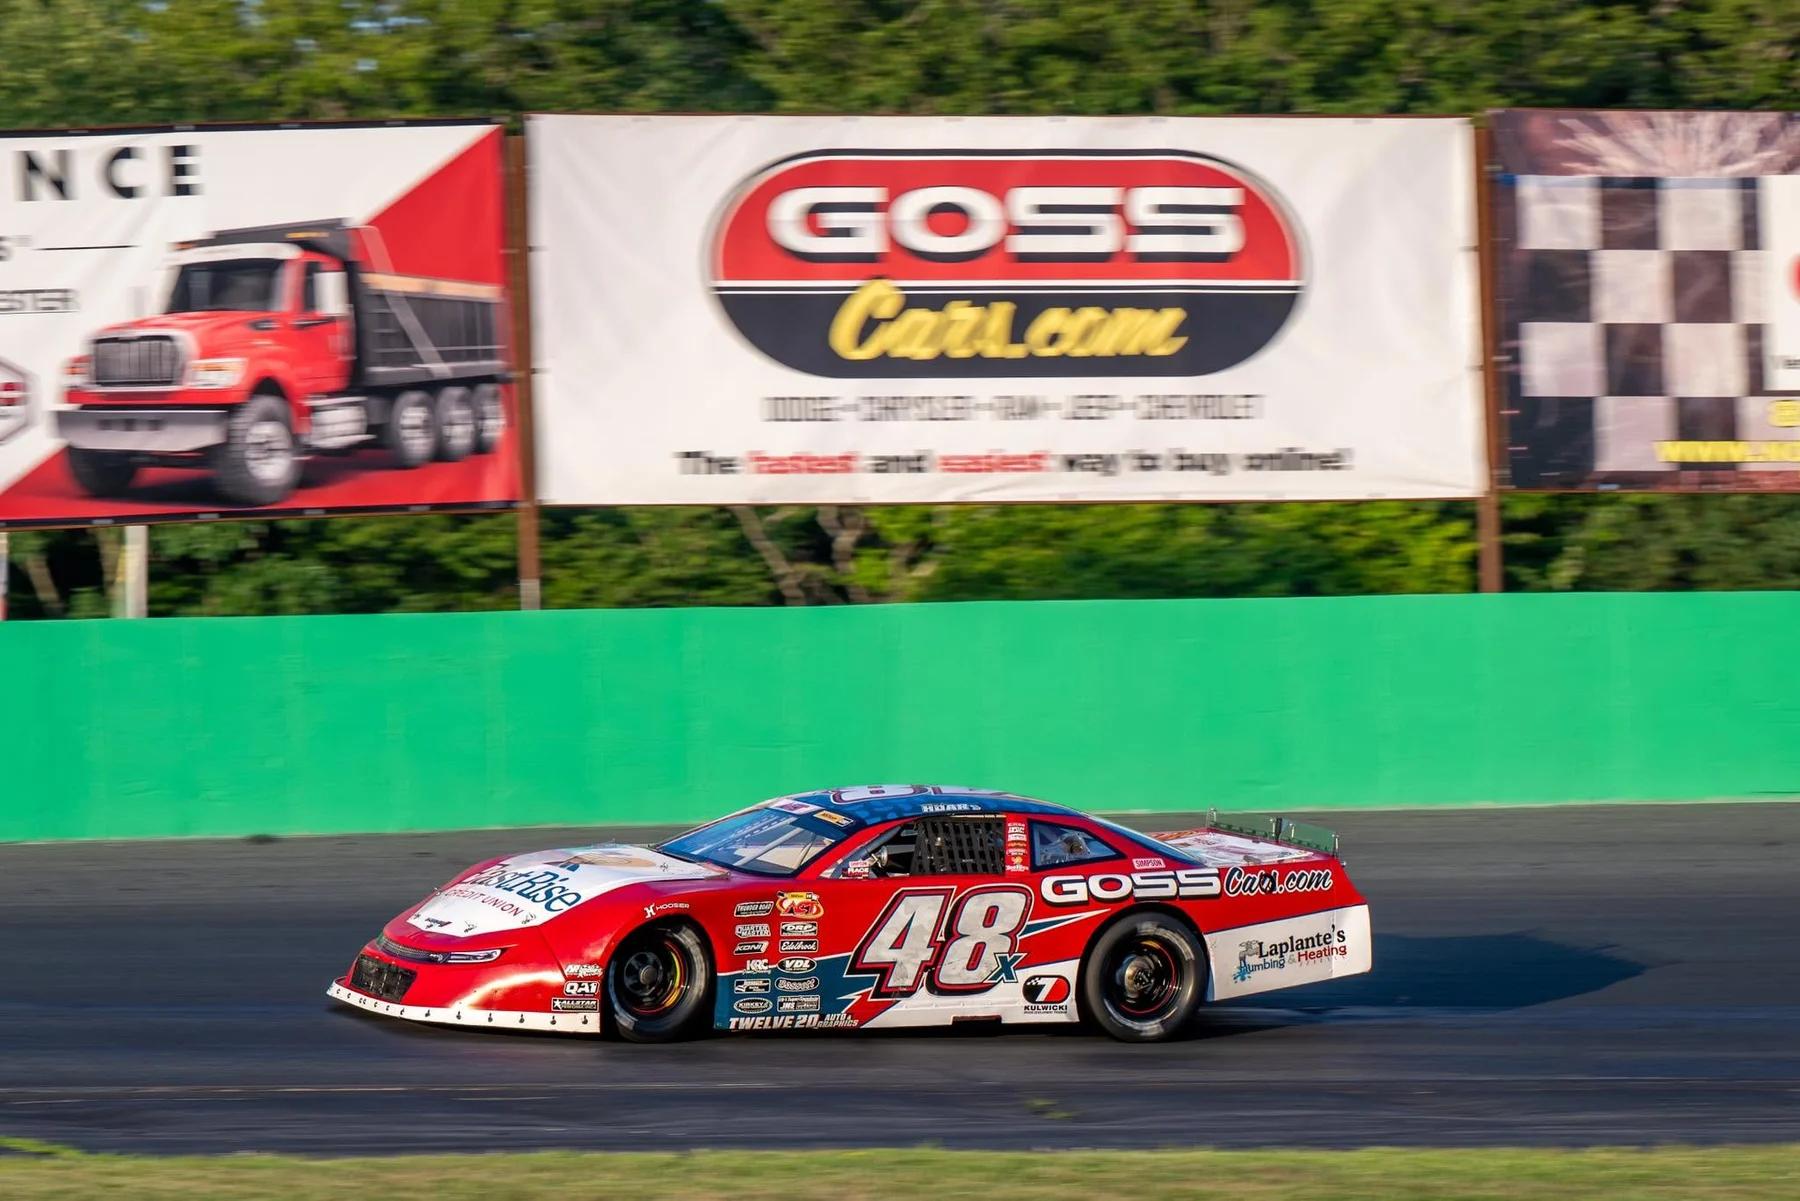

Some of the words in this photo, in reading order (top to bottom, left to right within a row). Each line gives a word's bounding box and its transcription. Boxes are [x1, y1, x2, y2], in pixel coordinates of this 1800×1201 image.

[766, 187, 1247, 262] GOSS
[828, 278, 1188, 360] Cars.com
[674, 450, 740, 474] The
[746, 450, 860, 474] fastest
[864, 449, 934, 473] and
[939, 449, 1053, 473] easiest
[1061, 453, 1118, 477] way
[1124, 450, 1163, 472] to
[1166, 448, 1230, 476] buy
[459, 863, 582, 912] EastRise
[1041, 868, 1222, 906] GOSS
[484, 895, 524, 917] UNION
[852, 886, 1032, 993] 48
[1259, 924, 1346, 958] Laplante's
[1297, 945, 1347, 962] Heating
[785, 960, 811, 968] VDL
[565, 982, 598, 995] QA1
[729, 1016, 795, 1031] TWELVE
[817, 1020, 860, 1029] GRAPHICS
